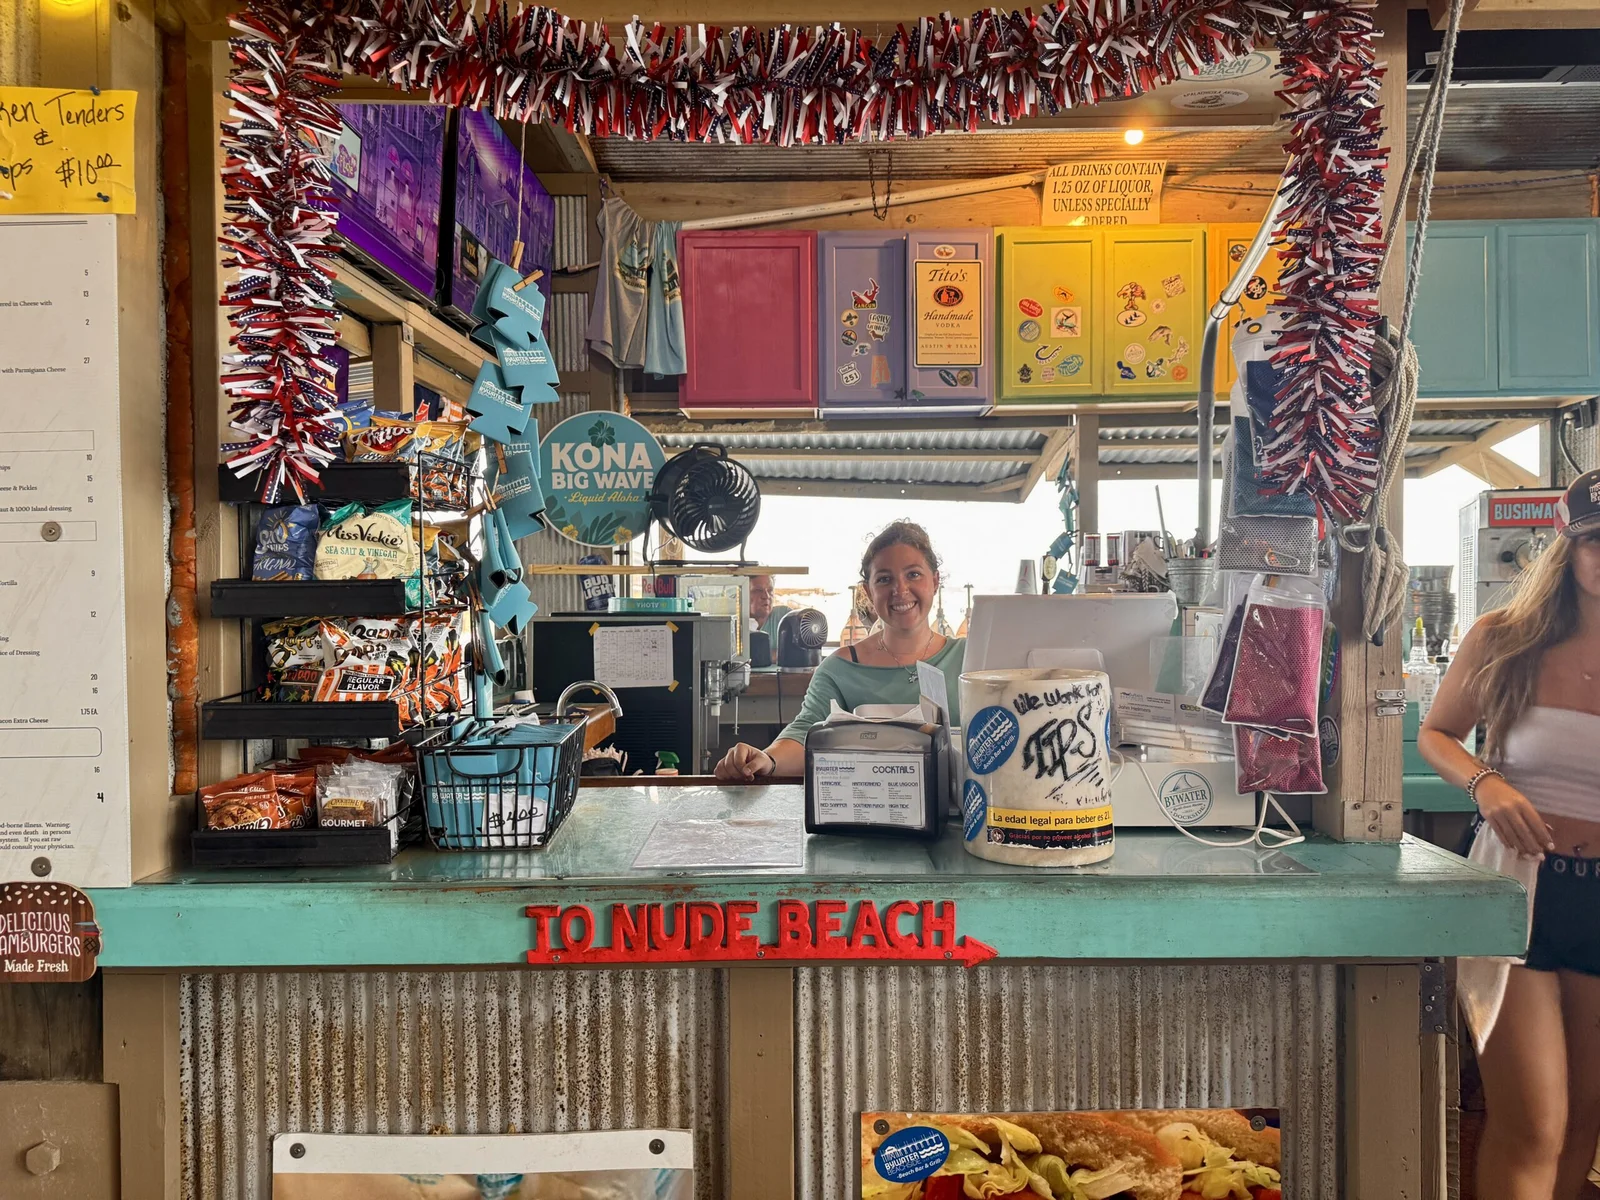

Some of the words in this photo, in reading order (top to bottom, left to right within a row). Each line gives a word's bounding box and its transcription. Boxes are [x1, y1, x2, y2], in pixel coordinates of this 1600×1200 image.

[44, 91, 124, 126] Tenders
[34, 128, 54, 146] &
[1049, 166, 1069, 178] ALL
[1071, 164, 1112, 176] DRINKS
[1114, 162, 1164, 176] CONTAIN
[1052, 180, 1072, 194] 1.25
[1074, 180, 1090, 194] OZ
[1092, 180, 1106, 193] OF
[1108, 180, 1154, 197] LIQUOR,
[1053, 198, 1092, 212] UNLESS
[1094, 197, 1152, 211] SPECIALLY
[1084, 216, 1128, 225] RDERED
[928, 267, 968, 282] Tito's
[923, 310, 974, 321] Handmade
[844, 372, 859, 383] 251
[551, 442, 653, 472] KONA
[552, 472, 588, 489] BIG
[593, 472, 654, 489] WAVE
[568, 492, 606, 506] Liquid
[607, 491, 639, 503] Aloha
[356, 522, 404, 549] Vickie's
[325, 546, 338, 555] SEA
[340, 547, 356, 556] SALT
[359, 548, 366, 556] &
[367, 548, 398, 559] VINEGAR
[584, 575, 609, 589] BUD
[657, 577, 674, 594] Bull
[584, 584, 616, 600] LIGHT
[347, 676, 384, 684] REGULAR
[872, 766, 915, 774] COCKTAILS
[97, 792, 104, 803] 4
[1164, 789, 1208, 808] BYWATER
[993, 812, 1003, 821] La
[1005, 814, 1027, 824] edad
[1030, 816, 1052, 826] legal
[1054, 817, 1073, 826] para
[1076, 813, 1096, 824] beber
[1173, 806, 1206, 819] DOCKSIDE
[525, 904, 595, 952] TO
[612, 901, 760, 952] NUDE
[779, 900, 956, 950] BEACH
[4, 959, 34, 972] Made
[37, 959, 69, 972] Fresh
[884, 1151, 920, 1170] BYWATER
